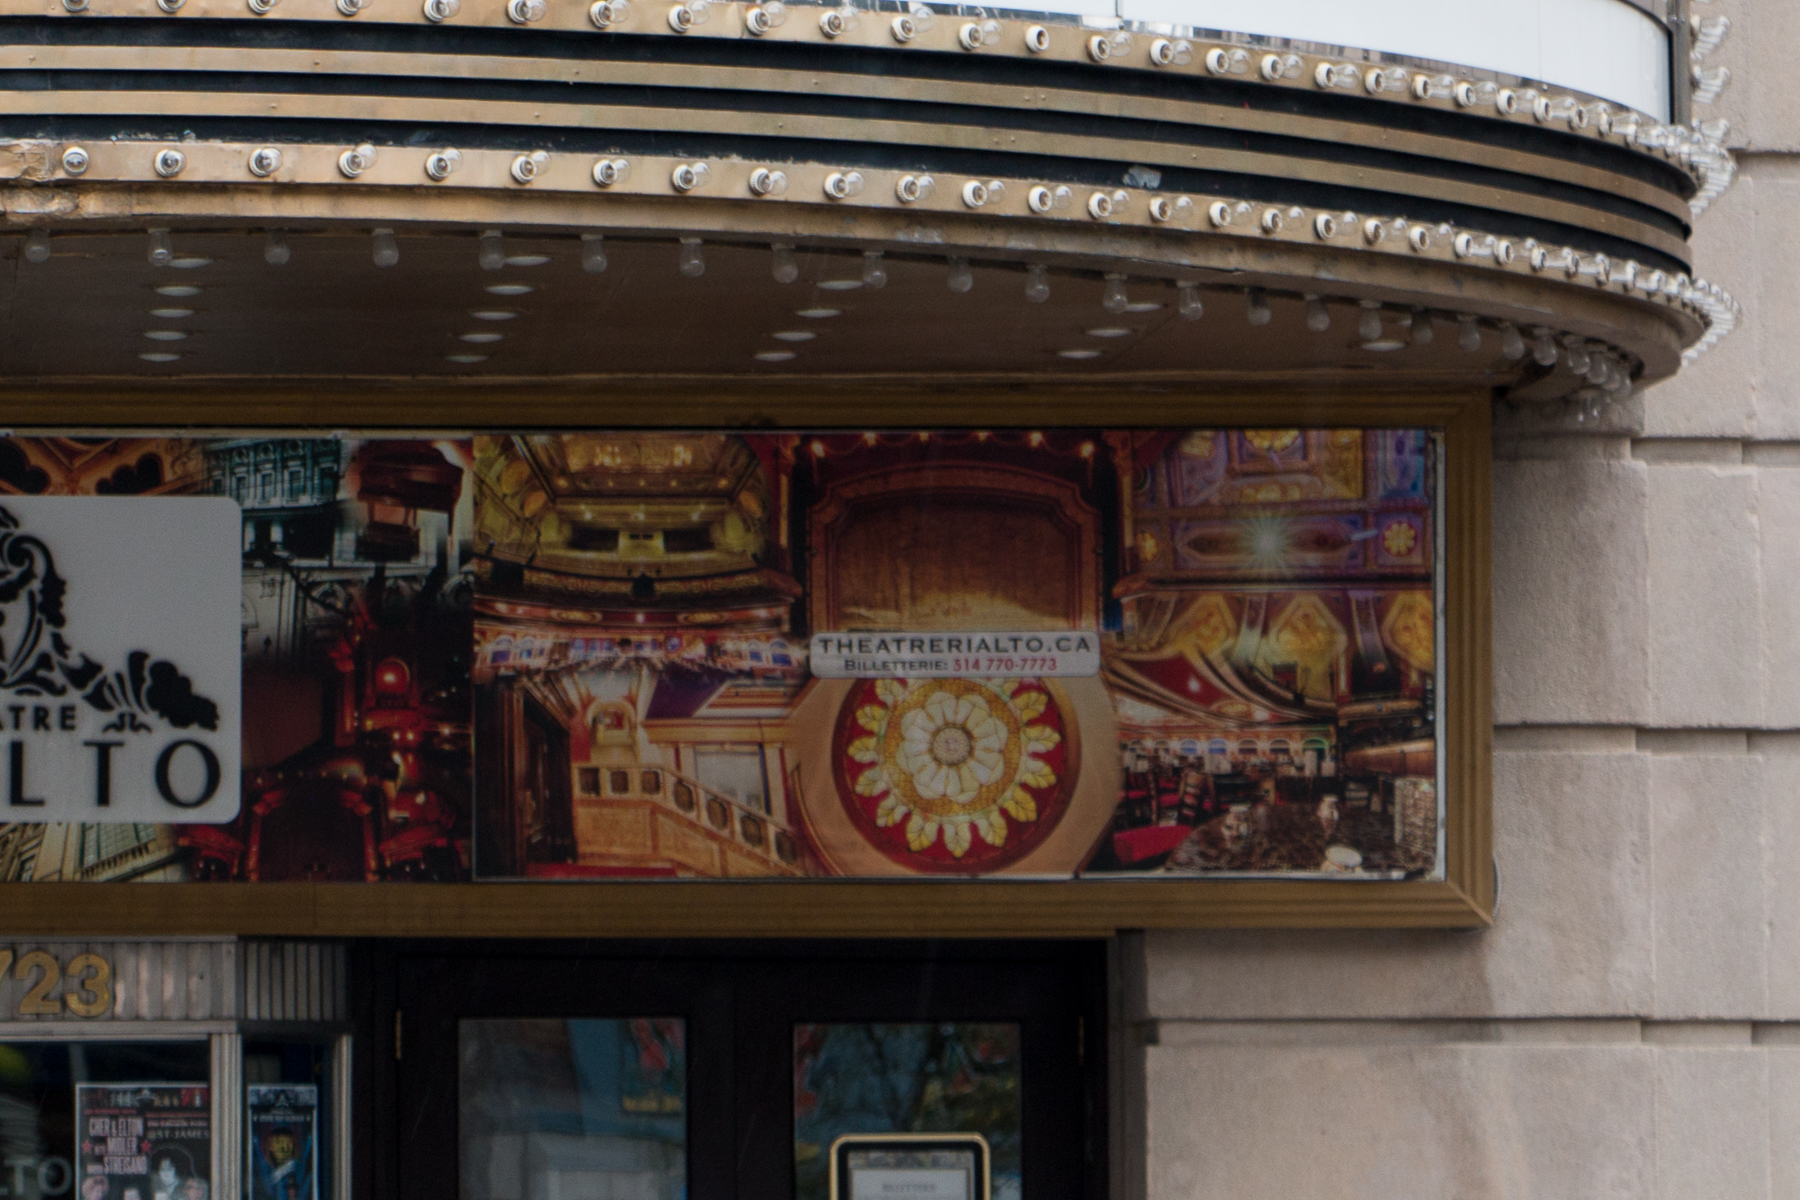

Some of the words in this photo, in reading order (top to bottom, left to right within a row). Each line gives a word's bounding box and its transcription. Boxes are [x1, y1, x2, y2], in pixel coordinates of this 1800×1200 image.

[819, 637, 1091, 654] THEATRERIALTO.CA
[952, 658, 981, 672] 514
[986, 658, 1058, 672] 770-7773
